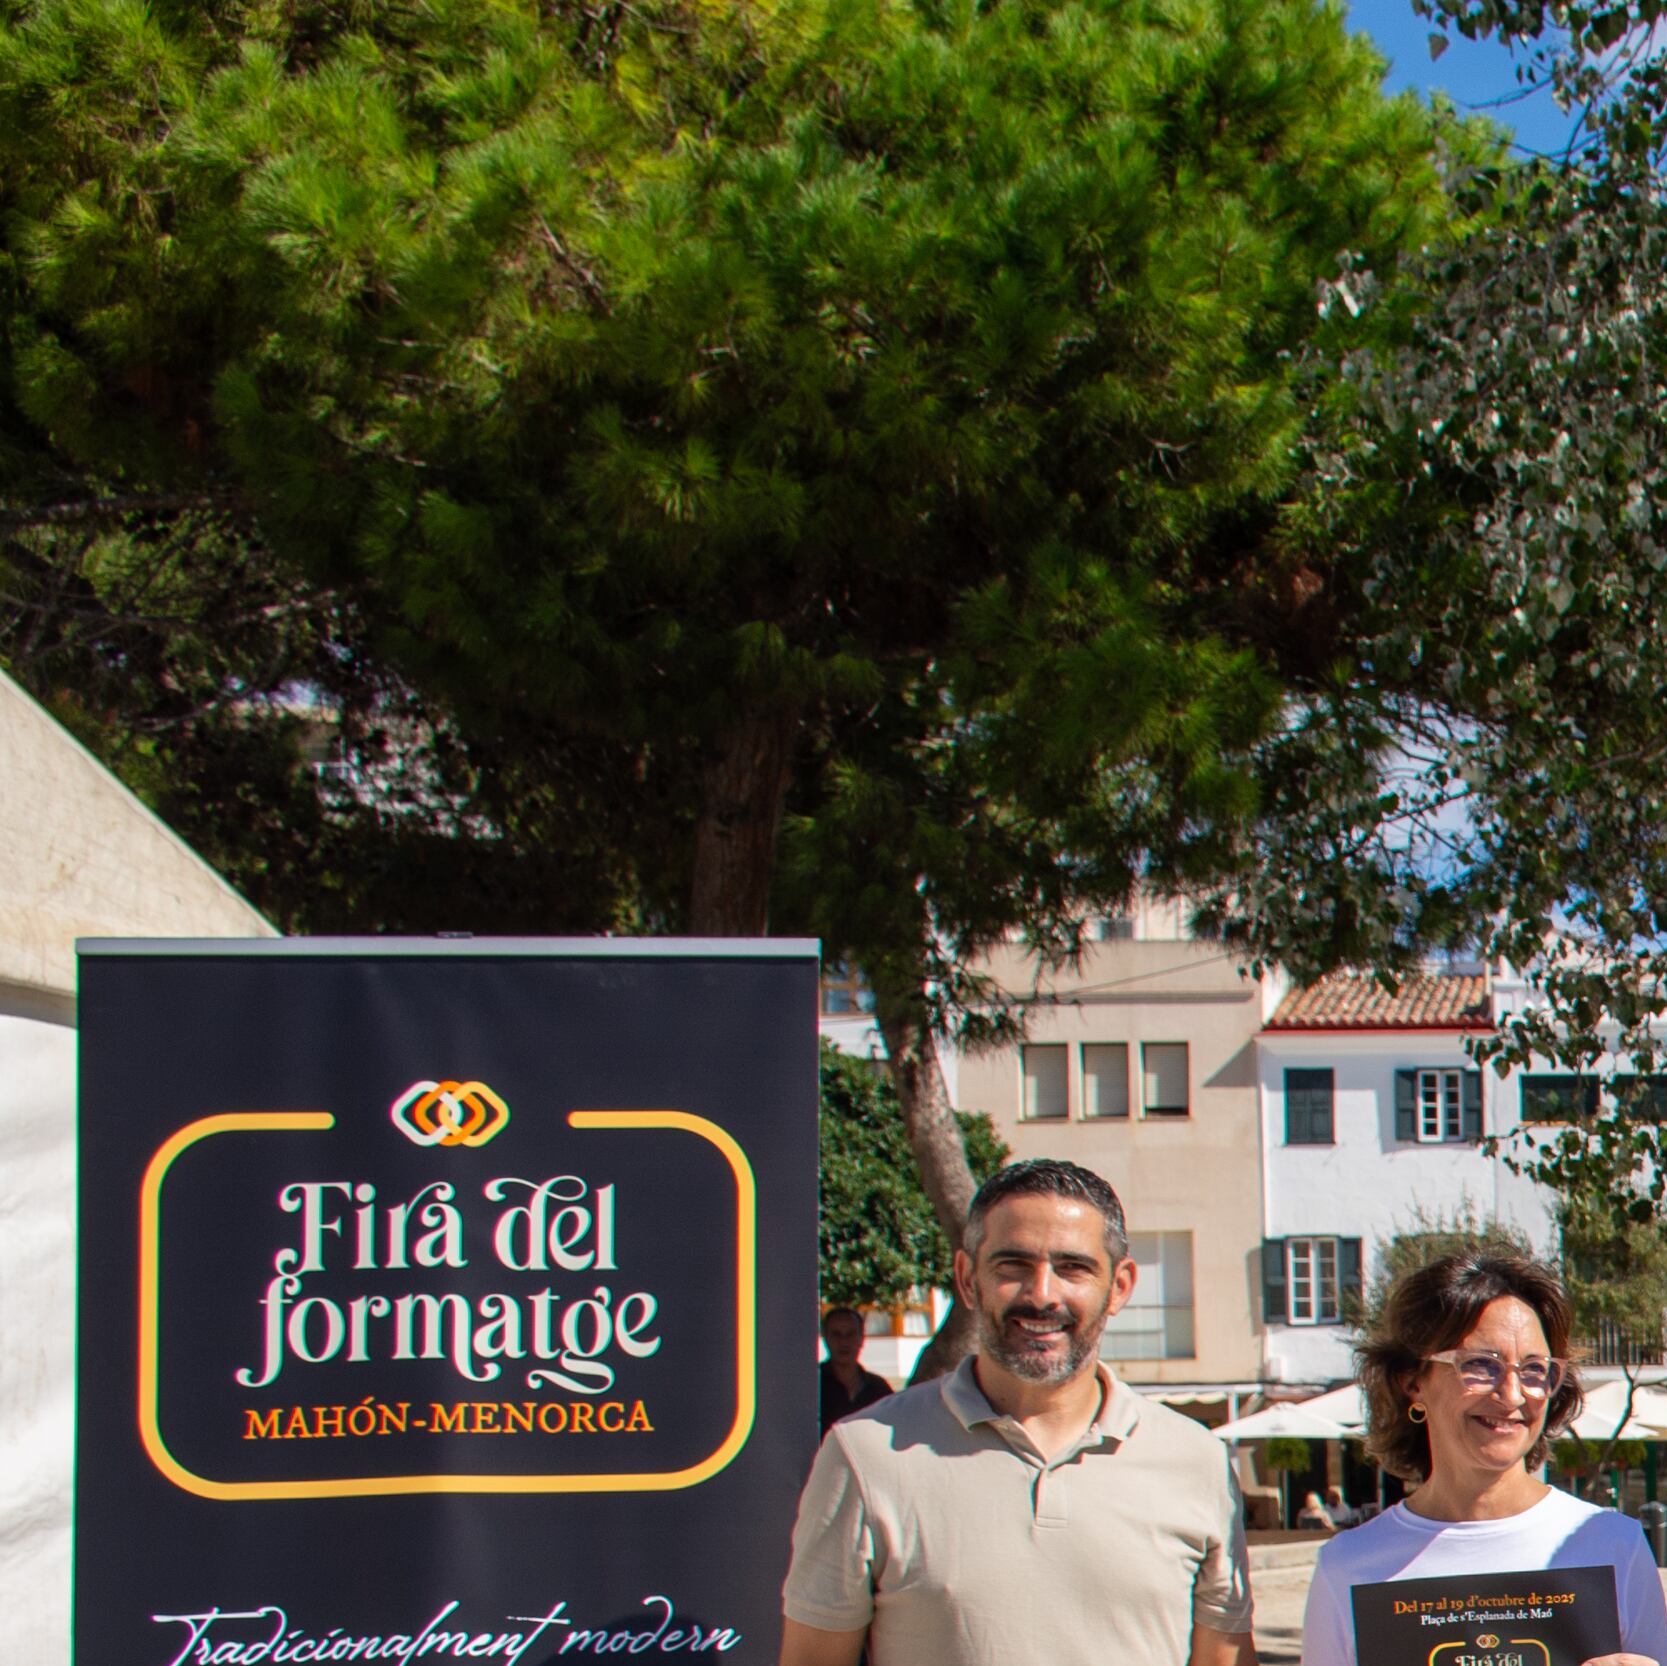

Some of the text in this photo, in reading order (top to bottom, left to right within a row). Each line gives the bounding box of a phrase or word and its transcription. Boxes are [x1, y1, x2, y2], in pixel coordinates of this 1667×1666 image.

[275, 1175, 618, 1277] Fira del
[234, 1274, 661, 1394] formatge
[242, 1397, 654, 1439] MAHÓN-MENORCA
[558, 1595, 741, 1655] modern
[1394, 1600, 1417, 1614] Del
[1421, 1602, 1434, 1613] 17
[1436, 1598, 1446, 1610] al
[1450, 1600, 1463, 1610] 19
[1528, 1593, 1541, 1605] de
[1545, 1594, 1575, 1604] 2025
[1421, 1615, 1445, 1626] Plaça
[1447, 1612, 1459, 1622] de
[1516, 1610, 1528, 1619] de
[1530, 1608, 1552, 1618] Maó
